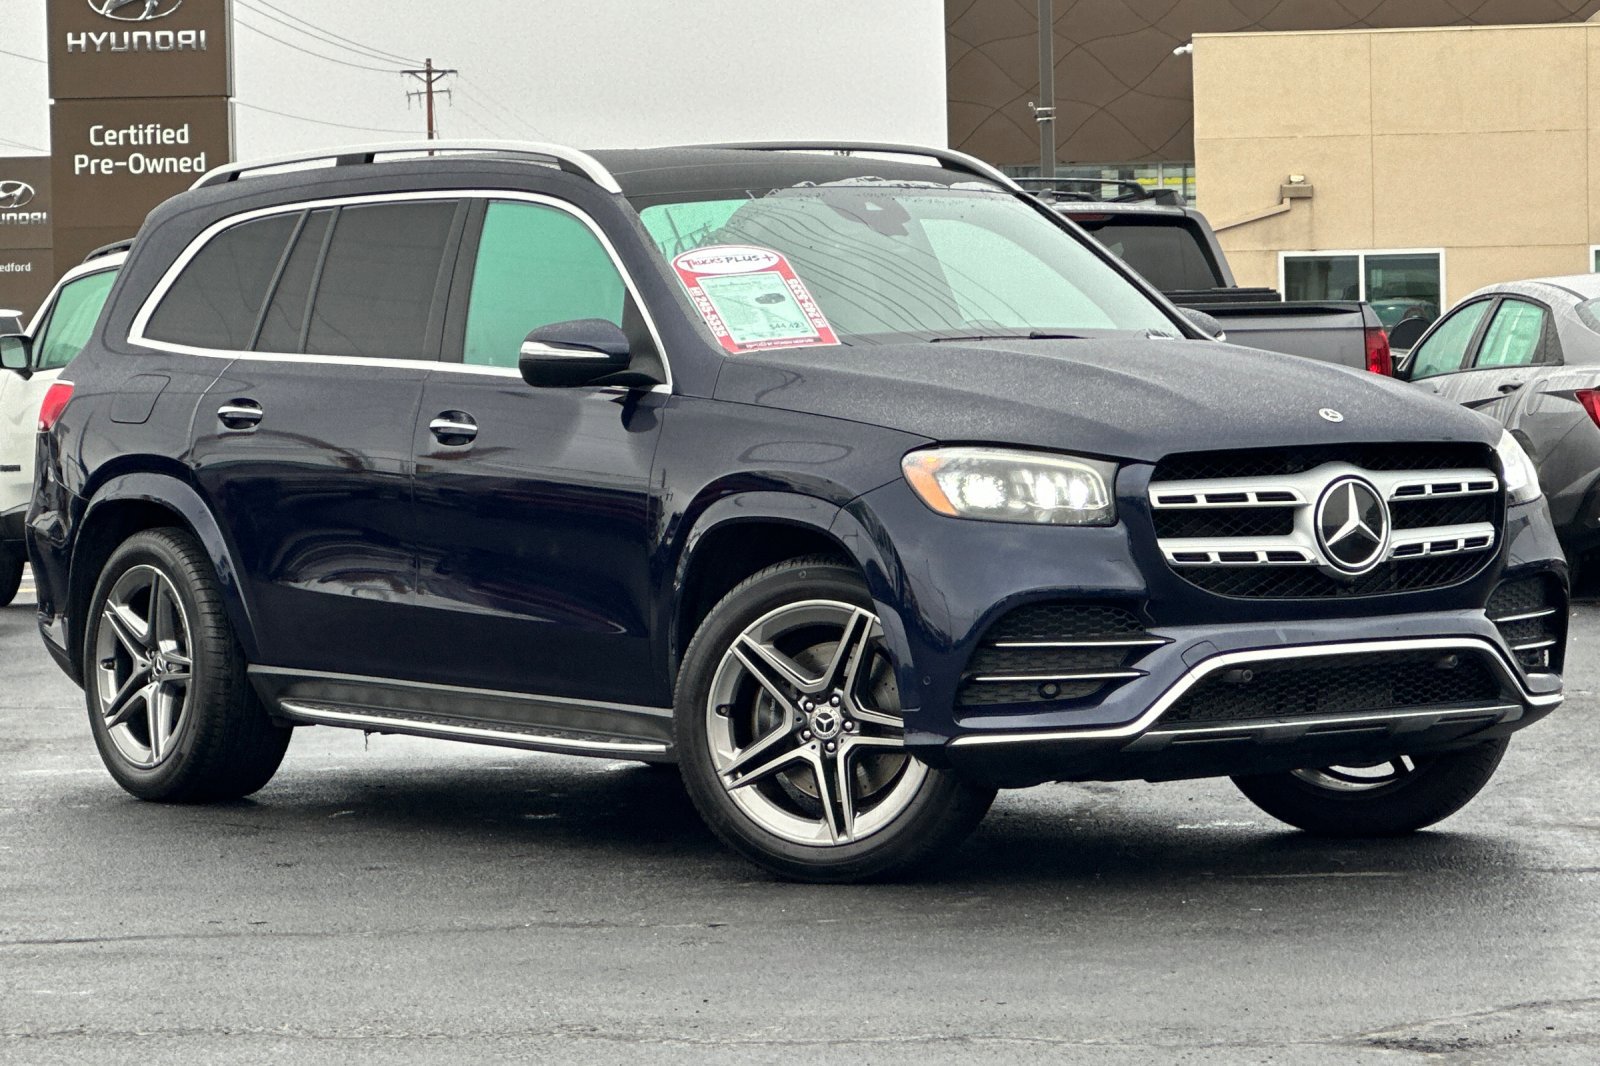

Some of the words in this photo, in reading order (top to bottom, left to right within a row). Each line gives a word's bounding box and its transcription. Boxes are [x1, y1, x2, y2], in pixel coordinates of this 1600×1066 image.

[66, 30, 207, 52] HYUNDAI
[89, 124, 189, 146] Certified
[74, 152, 206, 175] Pre-Owned
